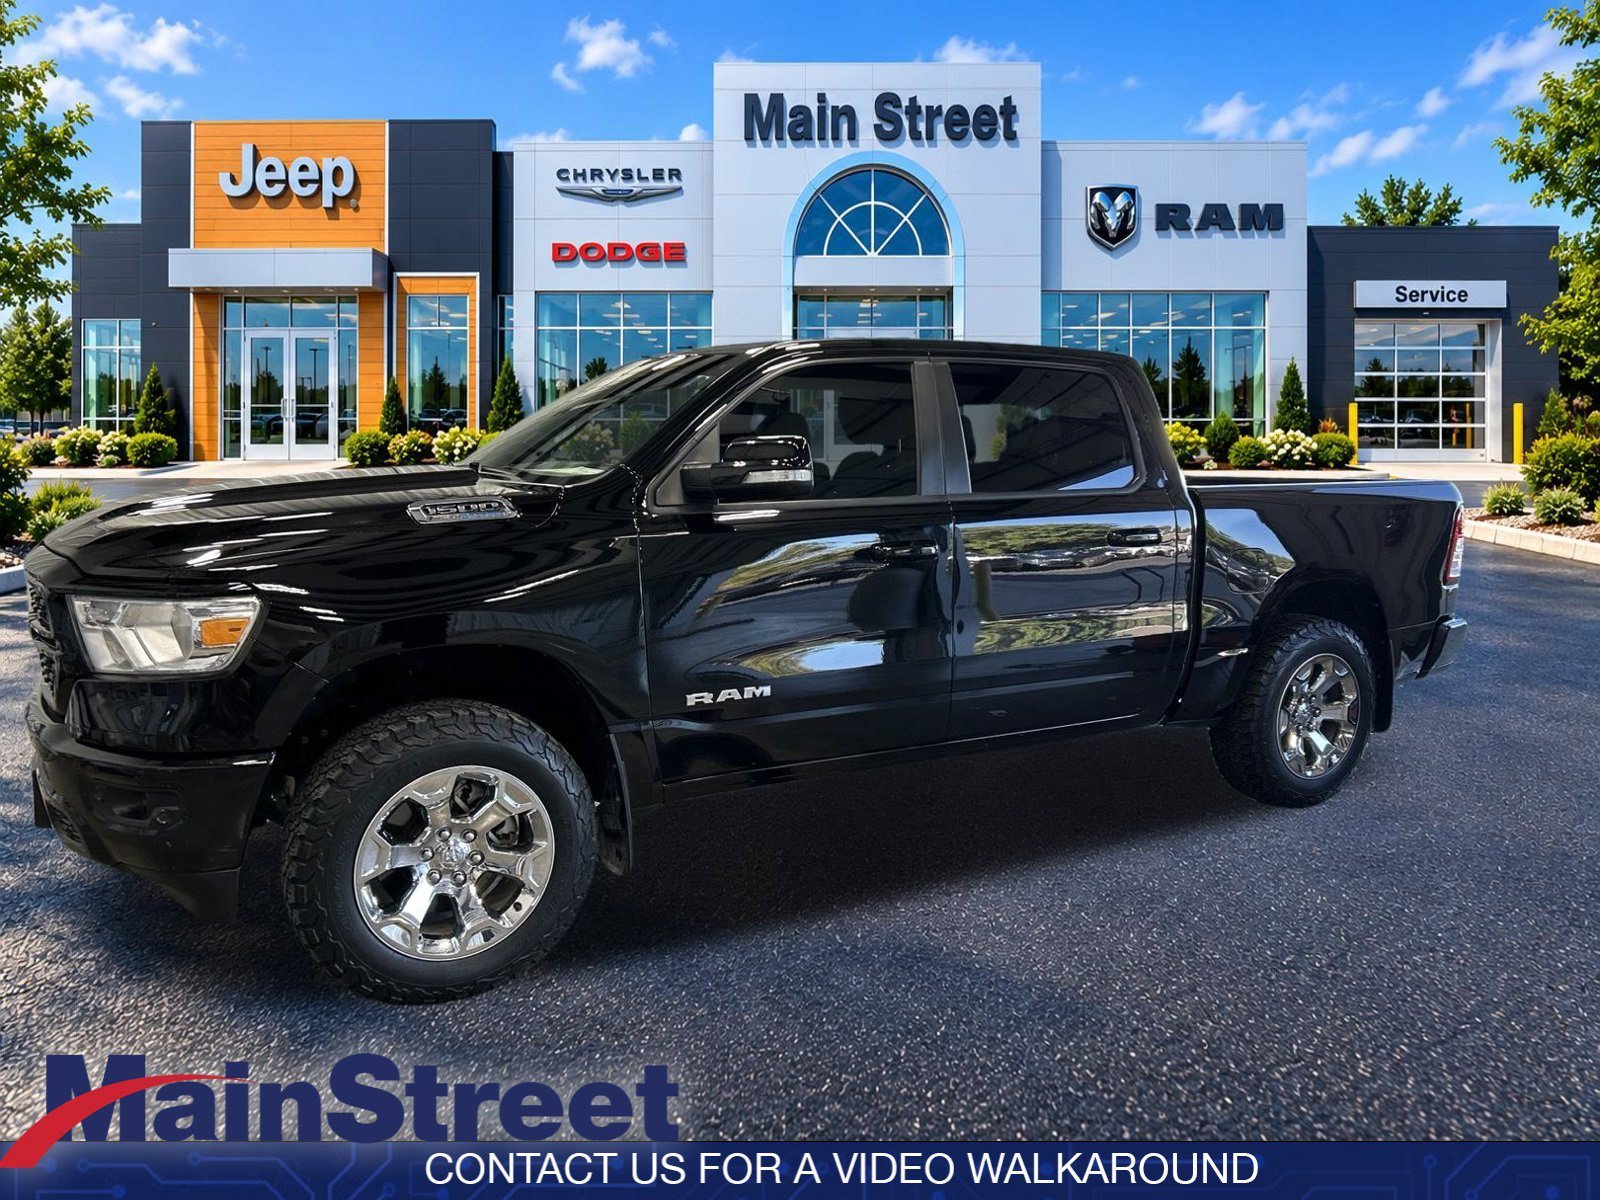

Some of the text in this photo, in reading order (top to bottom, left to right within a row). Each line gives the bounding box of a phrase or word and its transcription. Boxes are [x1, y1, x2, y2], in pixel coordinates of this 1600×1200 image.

[743, 92, 1018, 142] Main Street
[218, 143, 355, 208] Jeep
[556, 168, 683, 182] CHRYSLER
[1155, 203, 1284, 231] RAM
[551, 242, 687, 262] DODGE
[1395, 285, 1469, 303] Service
[424, 502, 499, 515] 1500
[685, 685, 771, 707] RAM
